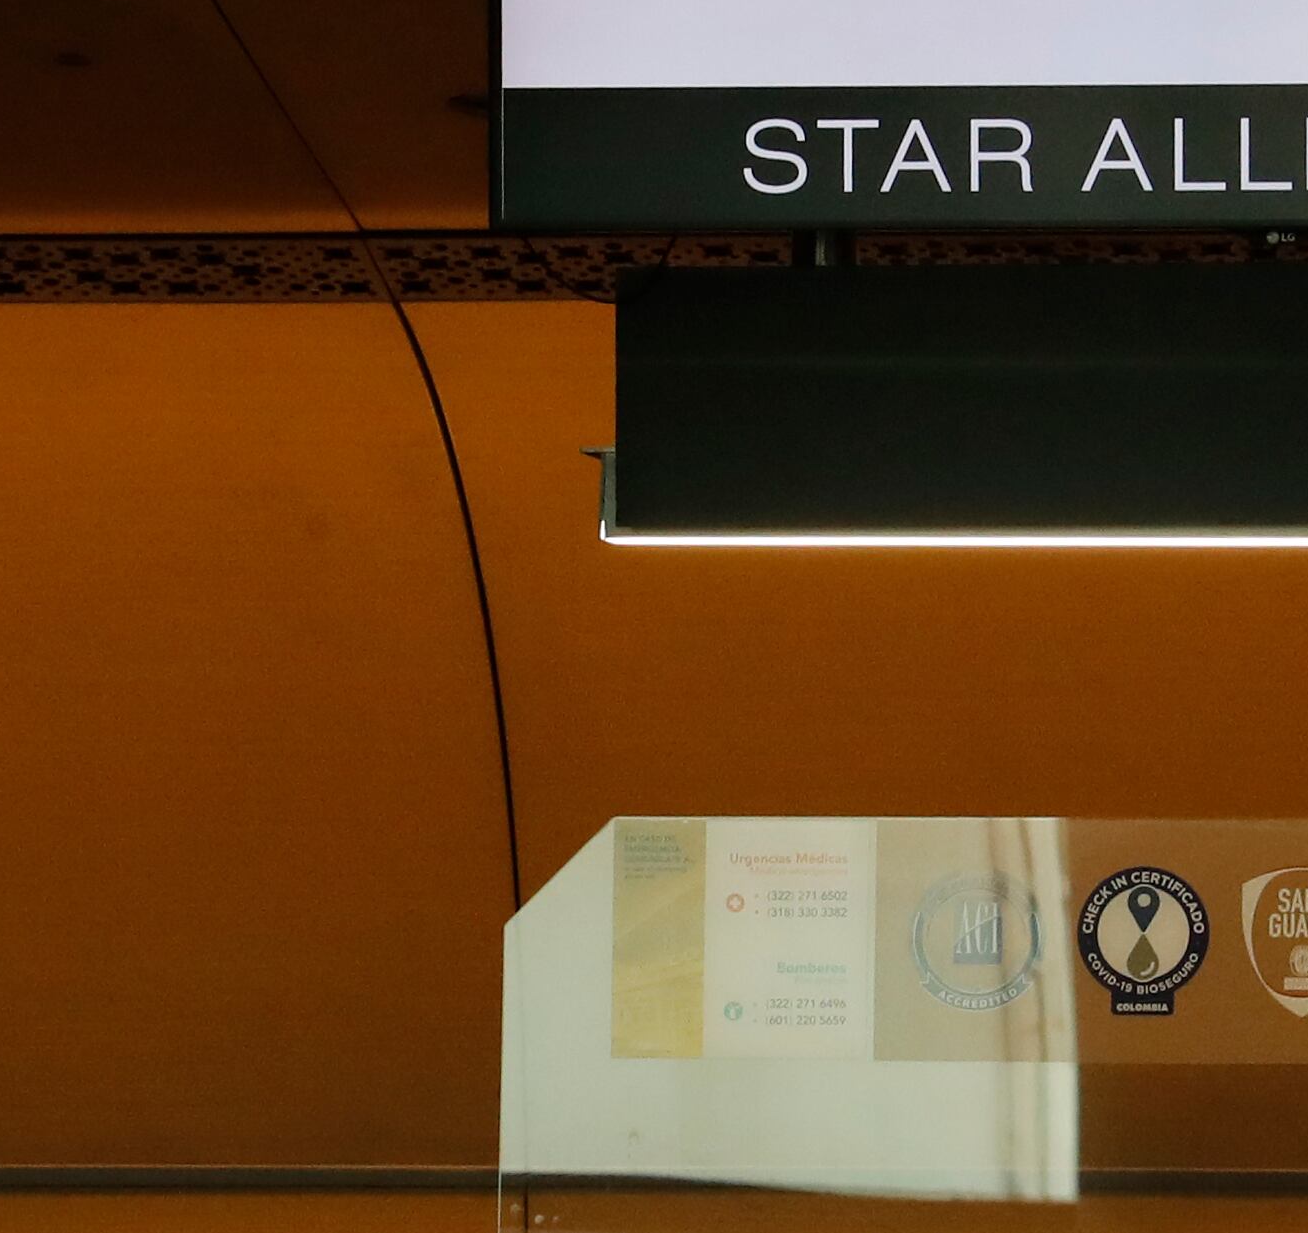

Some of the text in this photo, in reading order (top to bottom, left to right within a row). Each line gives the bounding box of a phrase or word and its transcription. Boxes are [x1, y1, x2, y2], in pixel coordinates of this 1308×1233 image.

[743, 118, 1034, 195] STAR
[1280, 232, 1296, 242] LG
[730, 852, 792, 867] Urgencias
[820, 889, 848, 902] 6502
[1082, 886, 1112, 934] CHECK
[1110, 874, 1128, 891] IN
[1130, 871, 1205, 934] CERTIFICADO
[776, 961, 847, 974] Bomberos
[1087, 953, 1199, 995] COVID-19 BIOSEGURO
[796, 998, 815, 1009] 271
[1116, 1003, 1169, 1012] COLOMBIA
